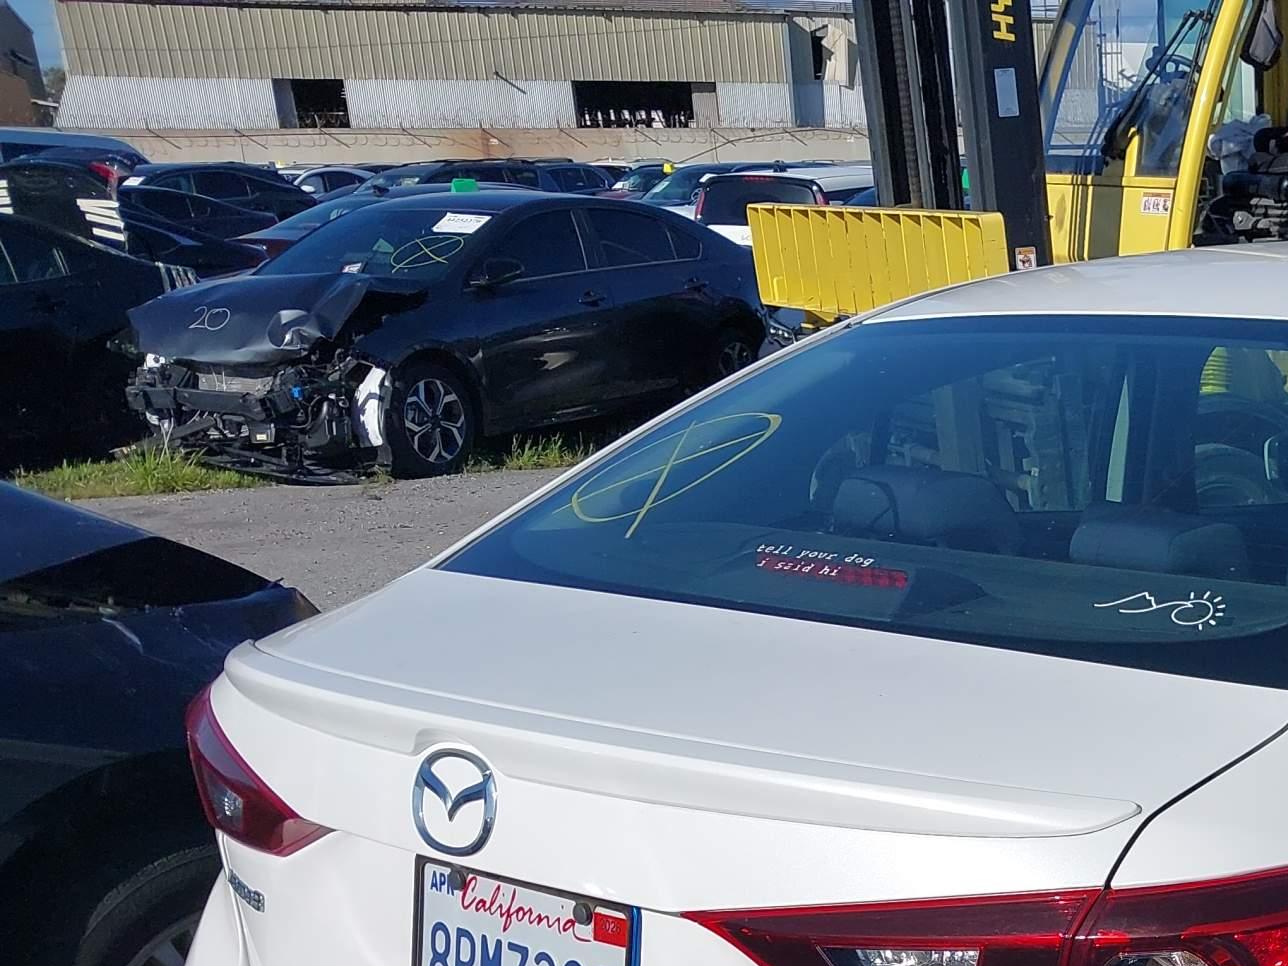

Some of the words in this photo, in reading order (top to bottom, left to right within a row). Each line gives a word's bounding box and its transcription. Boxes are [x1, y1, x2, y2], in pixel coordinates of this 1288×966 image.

[188, 305, 231, 331] 20
[757, 543, 792, 555] tell
[796, 549, 838, 559] your
[844, 554, 875, 567] dog
[757, 558, 769, 567] i
[774, 561, 815, 573] said
[818, 567, 842, 577] hi
[460, 876, 593, 943] California
